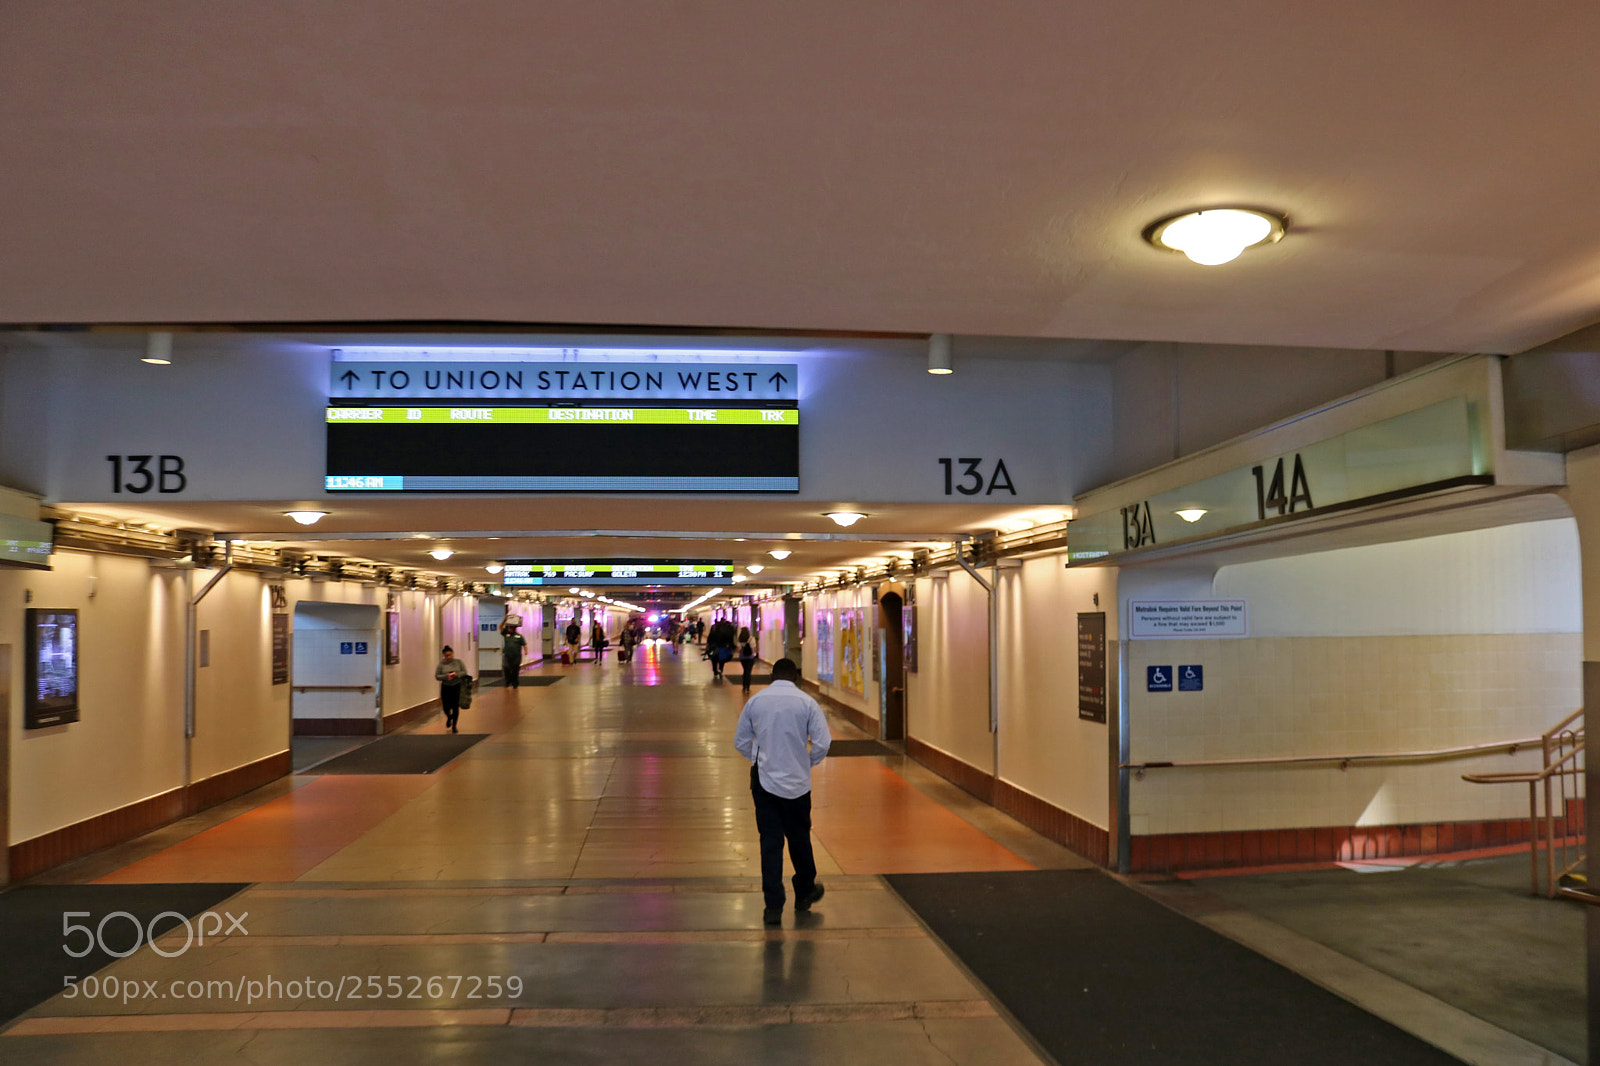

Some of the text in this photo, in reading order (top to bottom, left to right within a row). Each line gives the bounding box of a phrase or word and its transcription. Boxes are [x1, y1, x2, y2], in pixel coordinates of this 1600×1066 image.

[371, 370, 757, 392] TO UNION STATION WEST
[326, 408, 785, 421] CARRIER ID ROUTE DESTINATION TIME TRK
[106, 455, 187, 495] 13B
[938, 457, 1017, 496] 13A
[1252, 453, 1313, 521] 14A
[1120, 500, 1156, 550] 13A
